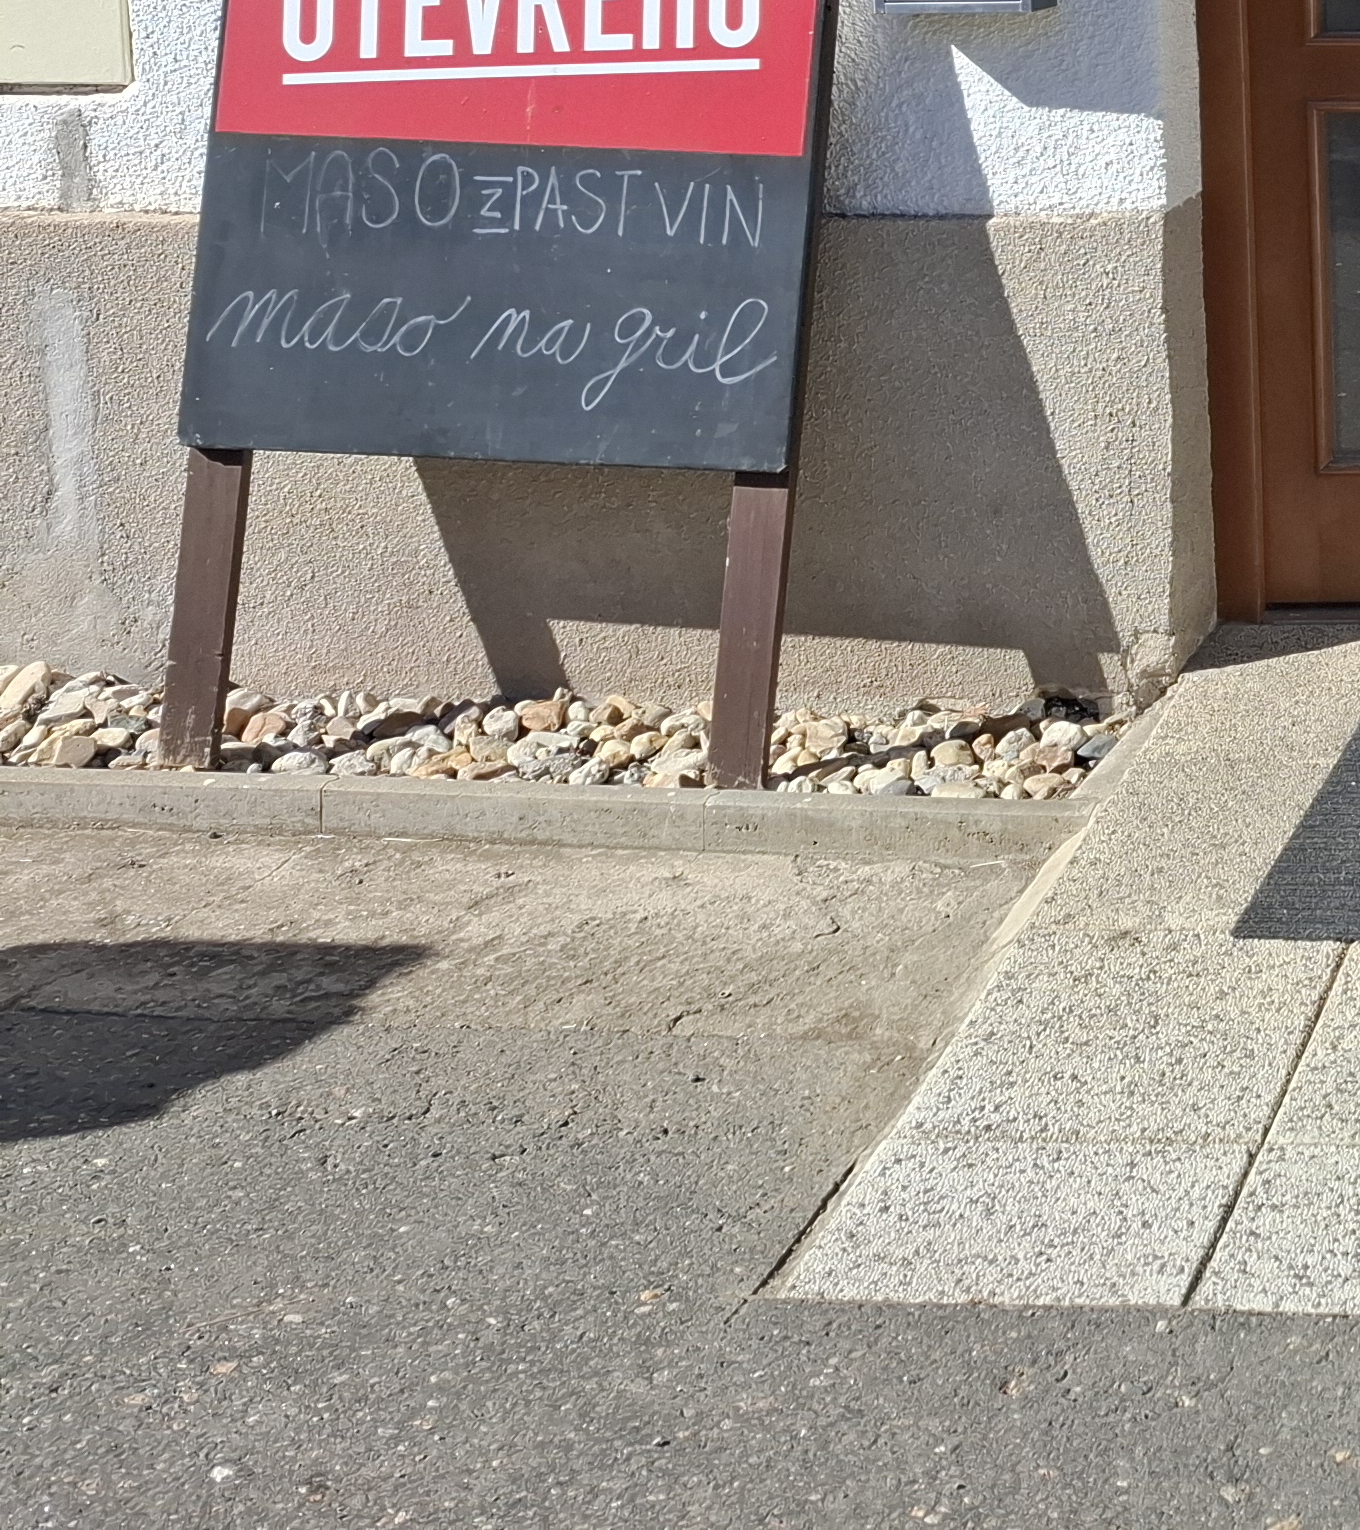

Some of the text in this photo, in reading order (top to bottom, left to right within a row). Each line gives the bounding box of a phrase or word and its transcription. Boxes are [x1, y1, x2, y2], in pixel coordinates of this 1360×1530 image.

[260, 147, 461, 235] MASO
[206, 289, 778, 410] maso na gril
